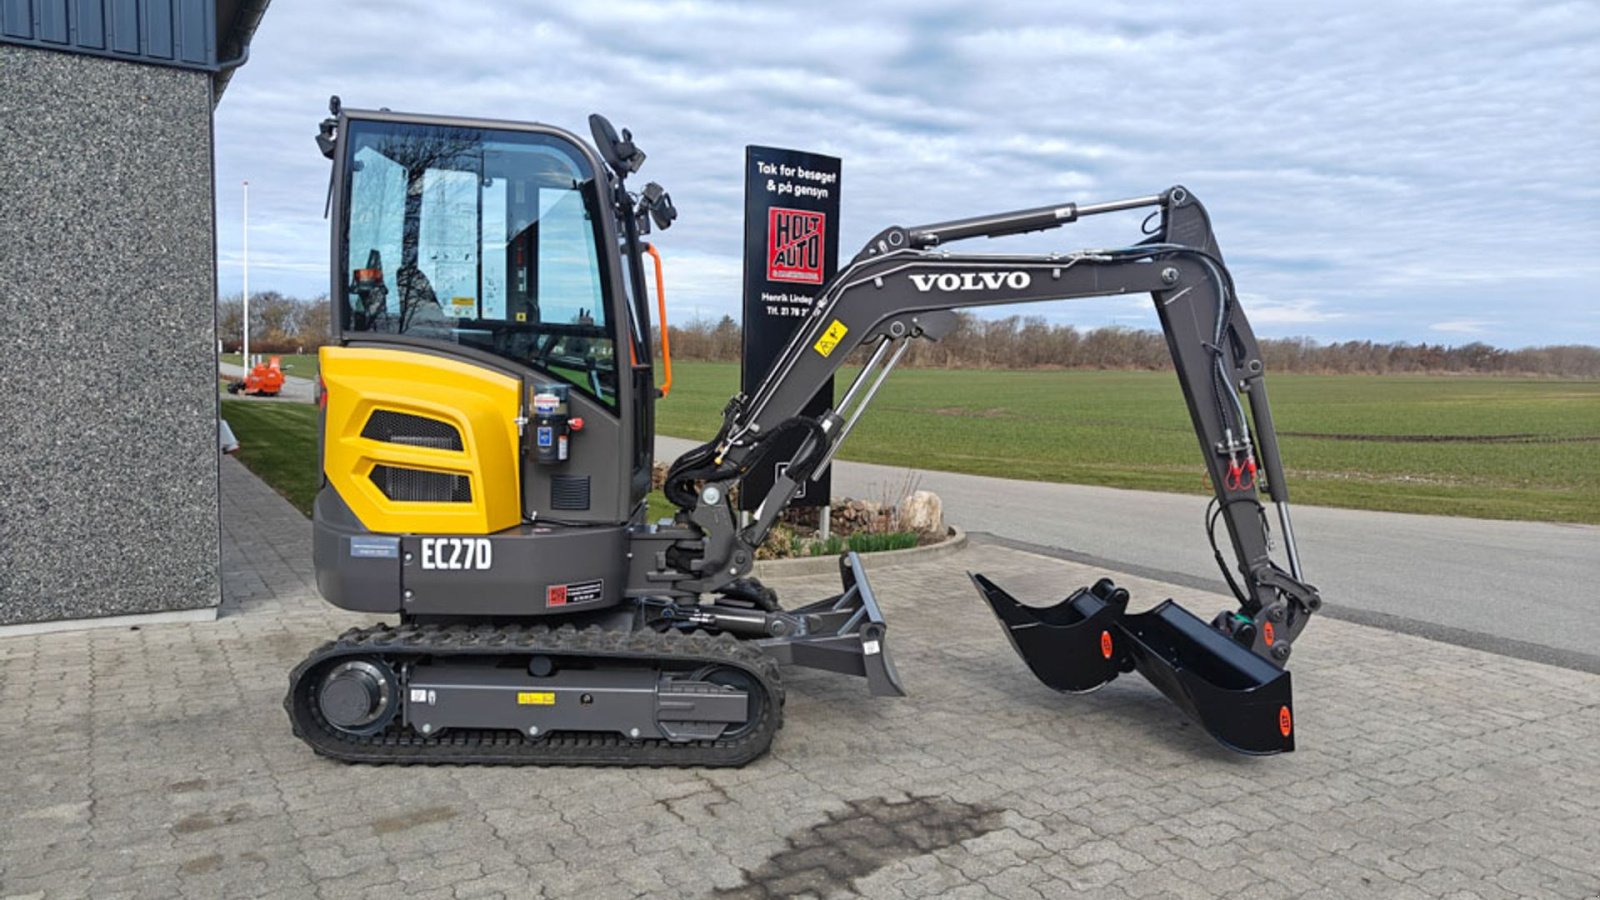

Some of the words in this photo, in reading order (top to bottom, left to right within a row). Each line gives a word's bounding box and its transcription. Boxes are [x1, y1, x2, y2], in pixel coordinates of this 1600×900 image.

[757, 161, 777, 175] Tak
[780, 164, 795, 177] for
[798, 166, 836, 184] besøget
[766, 179, 776, 191] &
[778, 181, 792, 195] på
[794, 185, 828, 200] gensyn
[776, 212, 820, 249] HOLT
[773, 233, 820, 269] AUTO
[908, 271, 1030, 291] VOLVO
[761, 292, 788, 302] Henrik
[421, 538, 492, 569] EC27D
